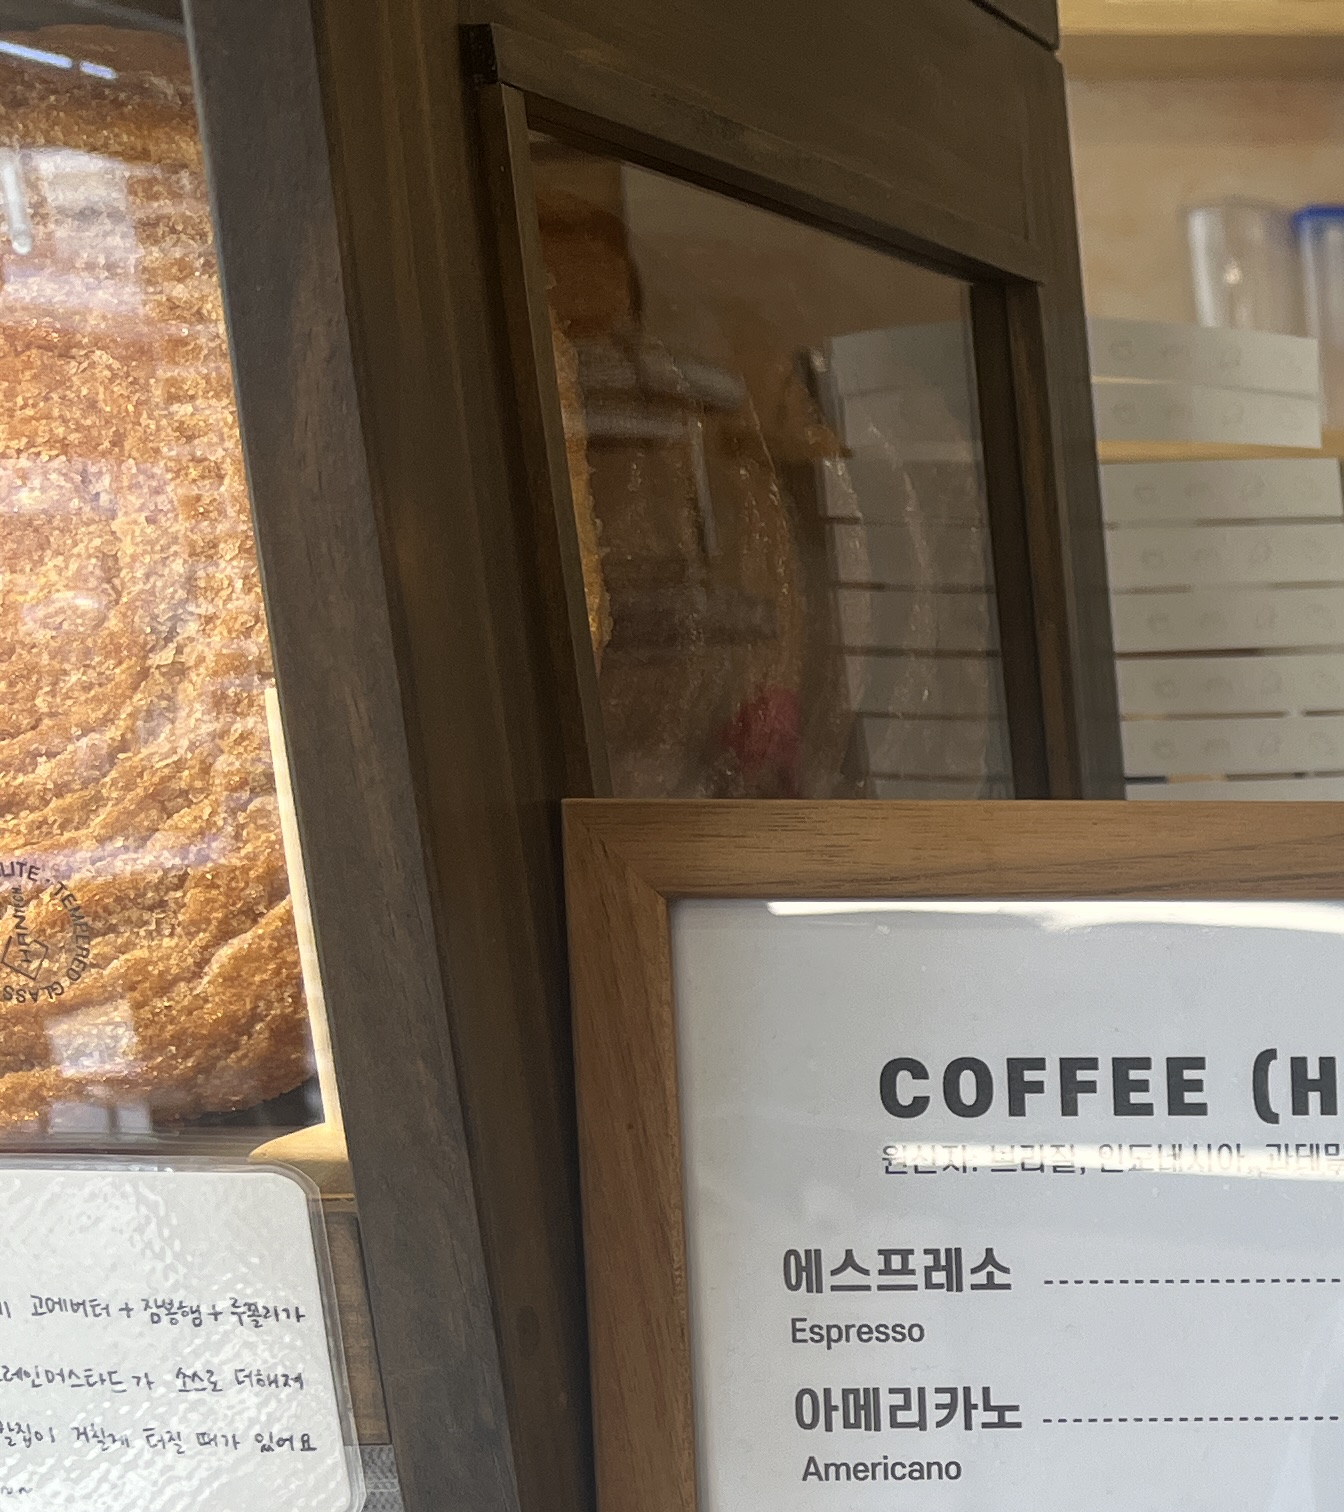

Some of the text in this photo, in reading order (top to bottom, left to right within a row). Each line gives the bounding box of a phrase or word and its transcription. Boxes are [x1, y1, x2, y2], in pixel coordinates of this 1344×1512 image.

[880, 1057, 1207, 1118] COFFEE
[783, 1247, 1011, 1293] 에스프레소
[791, 1318, 924, 1350] Espresso
[176, 1367, 223, 1392] 소스로
[795, 1386, 1022, 1432] 아메리카노
[196, 1432, 240, 1450] 때가
[255, 1432, 317, 1452] 있어요
[802, 1455, 961, 1481] Americano
